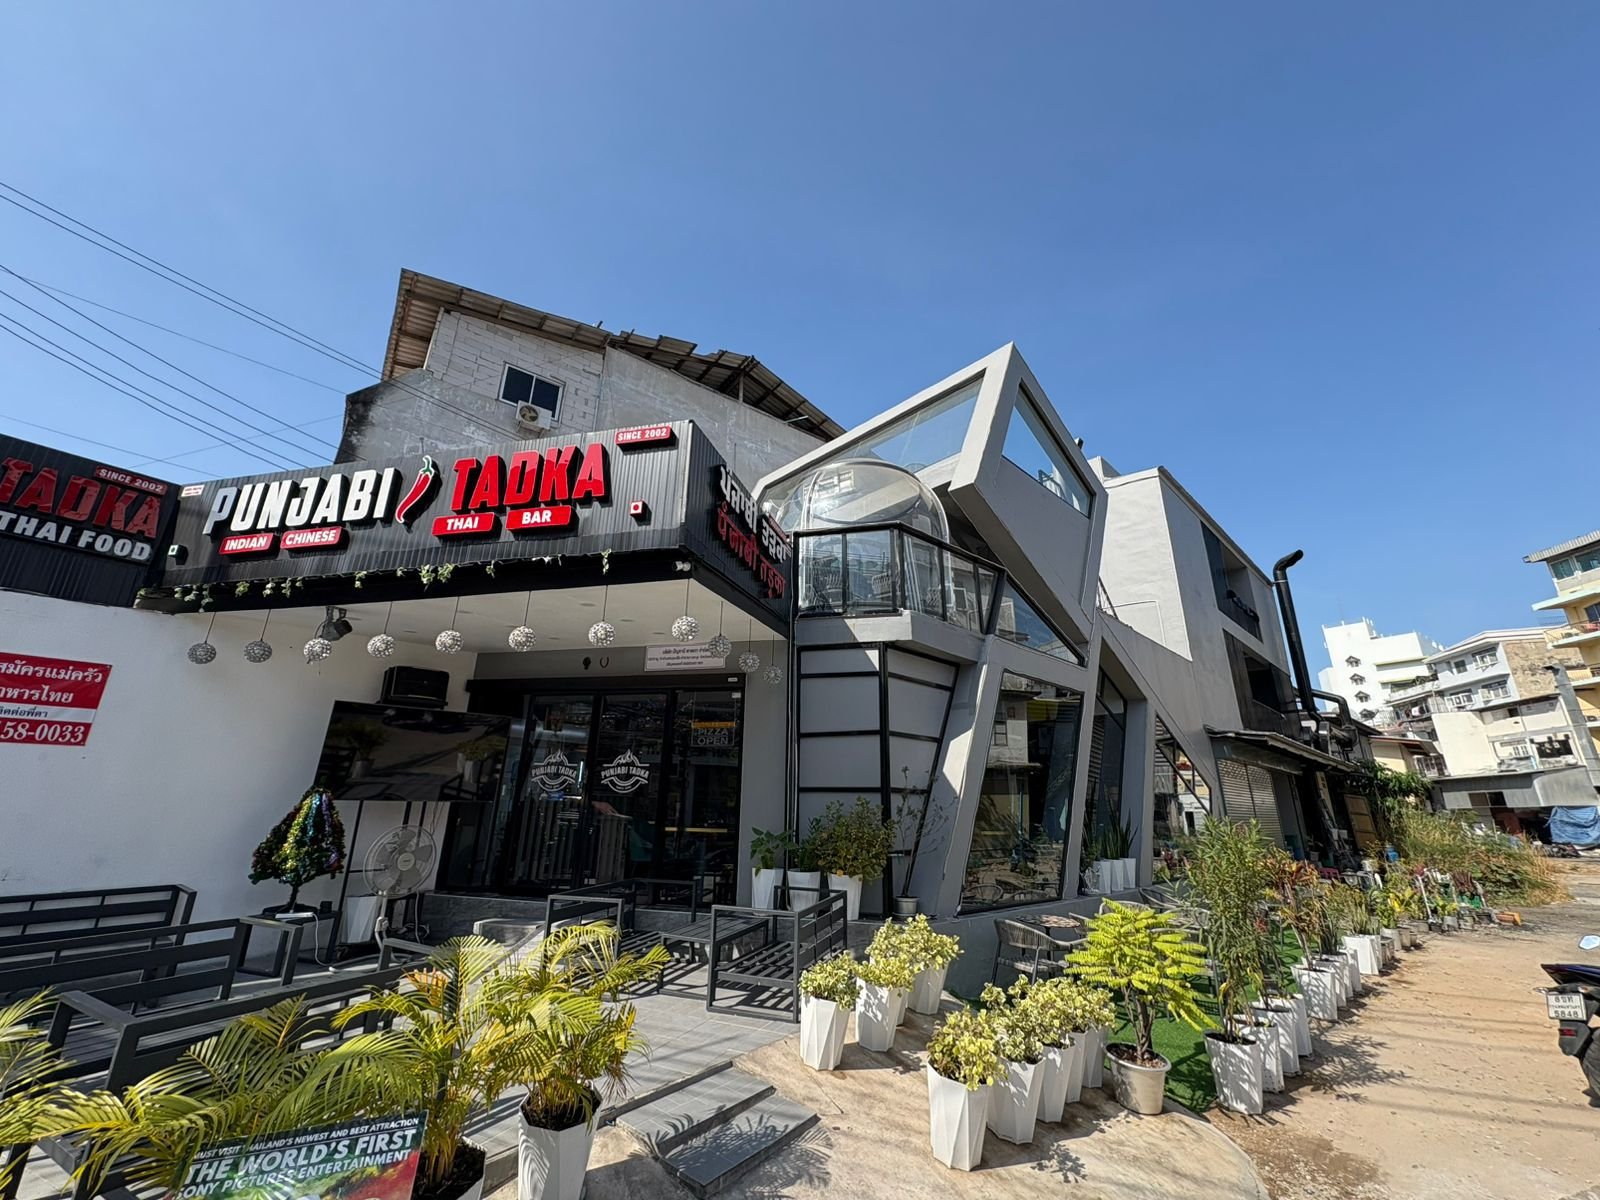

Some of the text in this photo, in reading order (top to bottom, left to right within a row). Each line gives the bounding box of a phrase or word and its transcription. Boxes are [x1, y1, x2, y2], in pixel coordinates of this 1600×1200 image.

[618, 428, 667, 441] SINCE 2002
[99, 468, 164, 492] SINCE 2002
[202, 442, 606, 535] PUNJABI TADKA
[0, 457, 162, 539] TADKA
[446, 516, 479, 531] THAI
[522, 510, 552, 525] BAR
[0, 511, 152, 561] THAI FOOD
[224, 535, 268, 551] INDIAN
[285, 529, 337, 546] CHINESE
[0, 721, 85, 743] 58-0033
[697, 737, 728, 745] OPEN
[532, 766, 578, 778] PUNJABI TADKA
[601, 766, 650, 779] PUNJABI TADKA
[218, 1145, 241, 1156] VISIT
[294, 1131, 330, 1145] NEWEST
[330, 1128, 349, 1139] AND
[349, 1124, 369, 1136] BEST
[369, 1117, 420, 1133] ATTRACTION
[184, 1128, 417, 1185] THE WORLD'S FIRST
[221, 1168, 295, 1193] PICTURES
[298, 1148, 412, 1179] ENTERTAINMENT
